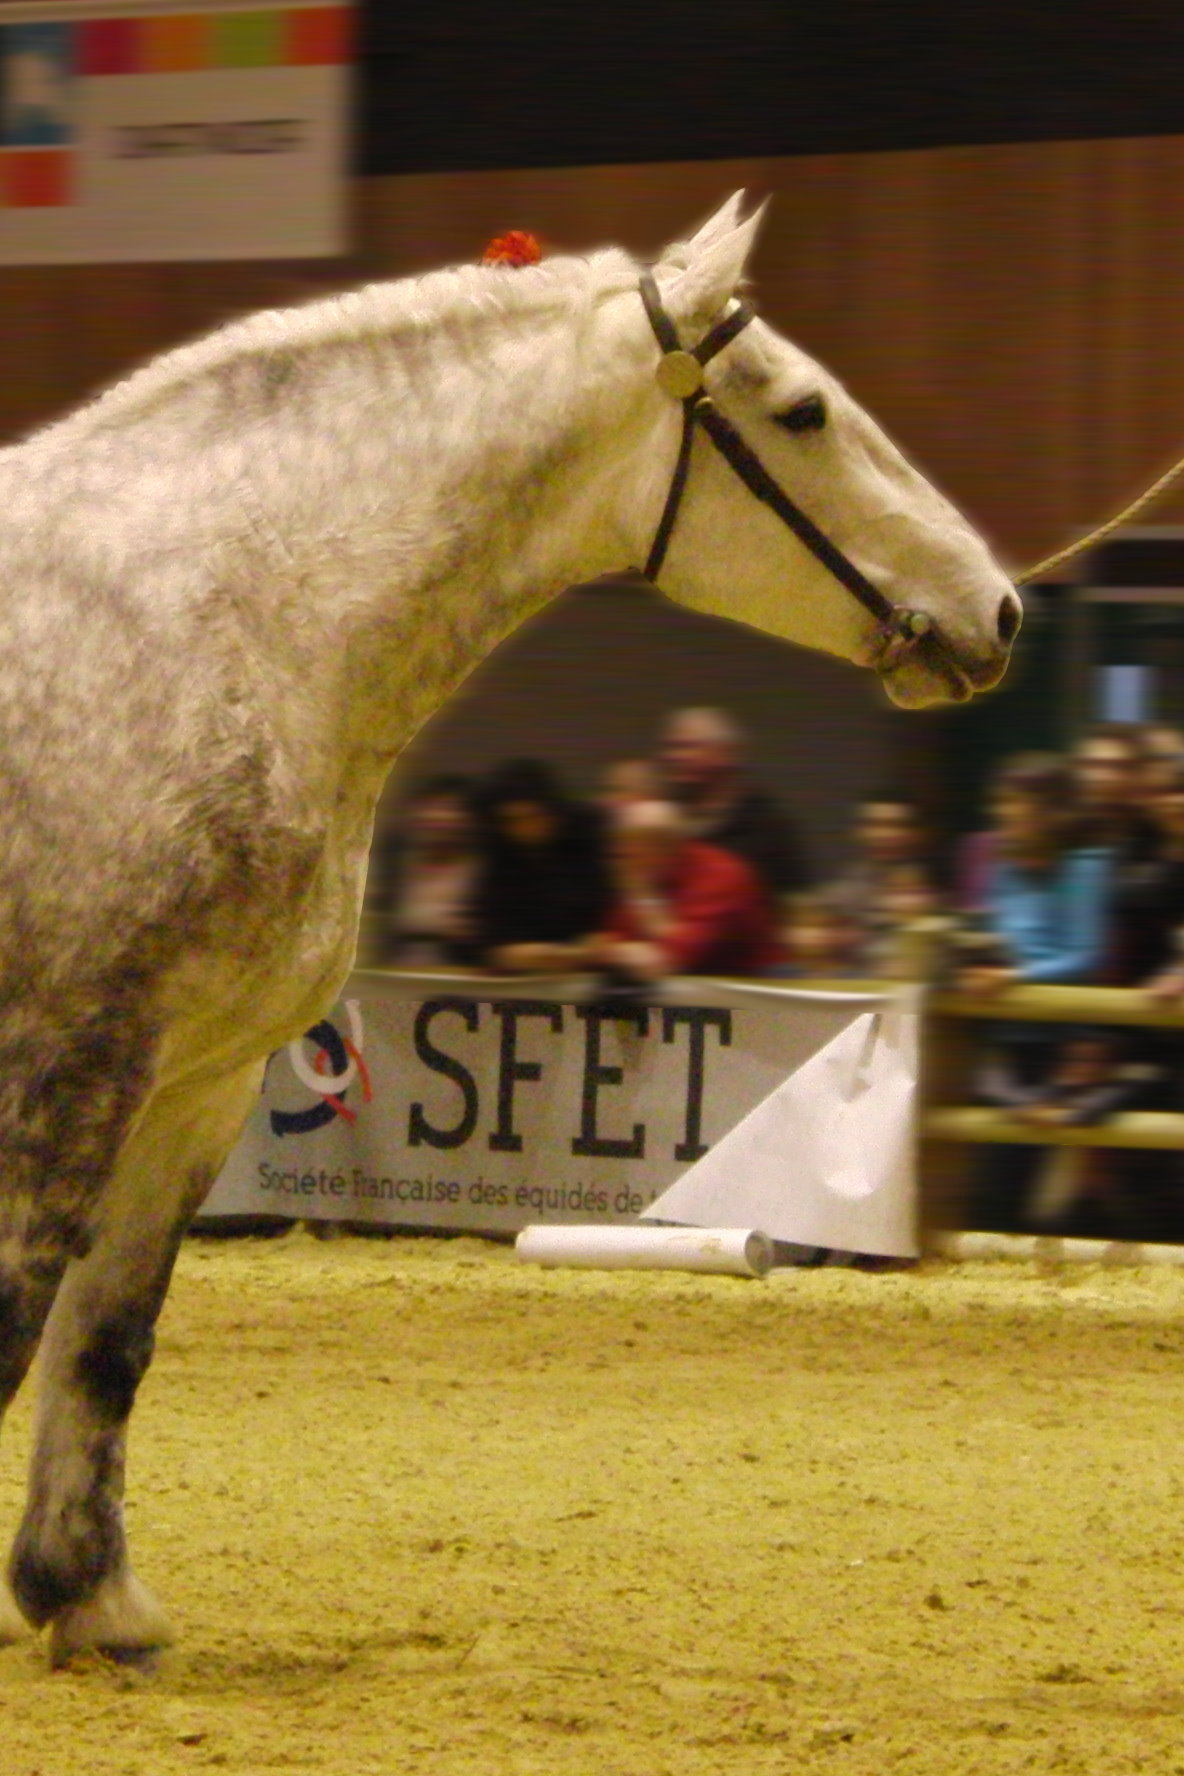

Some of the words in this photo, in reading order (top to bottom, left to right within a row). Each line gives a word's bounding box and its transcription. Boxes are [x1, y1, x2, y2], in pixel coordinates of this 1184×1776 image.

[408, 996, 732, 1161] SFET
[258, 1163, 347, 1196] Société
[469, 1176, 508, 1206] des
[517, 1179, 608, 1215] équidés
[616, 1184, 644, 1214] de
